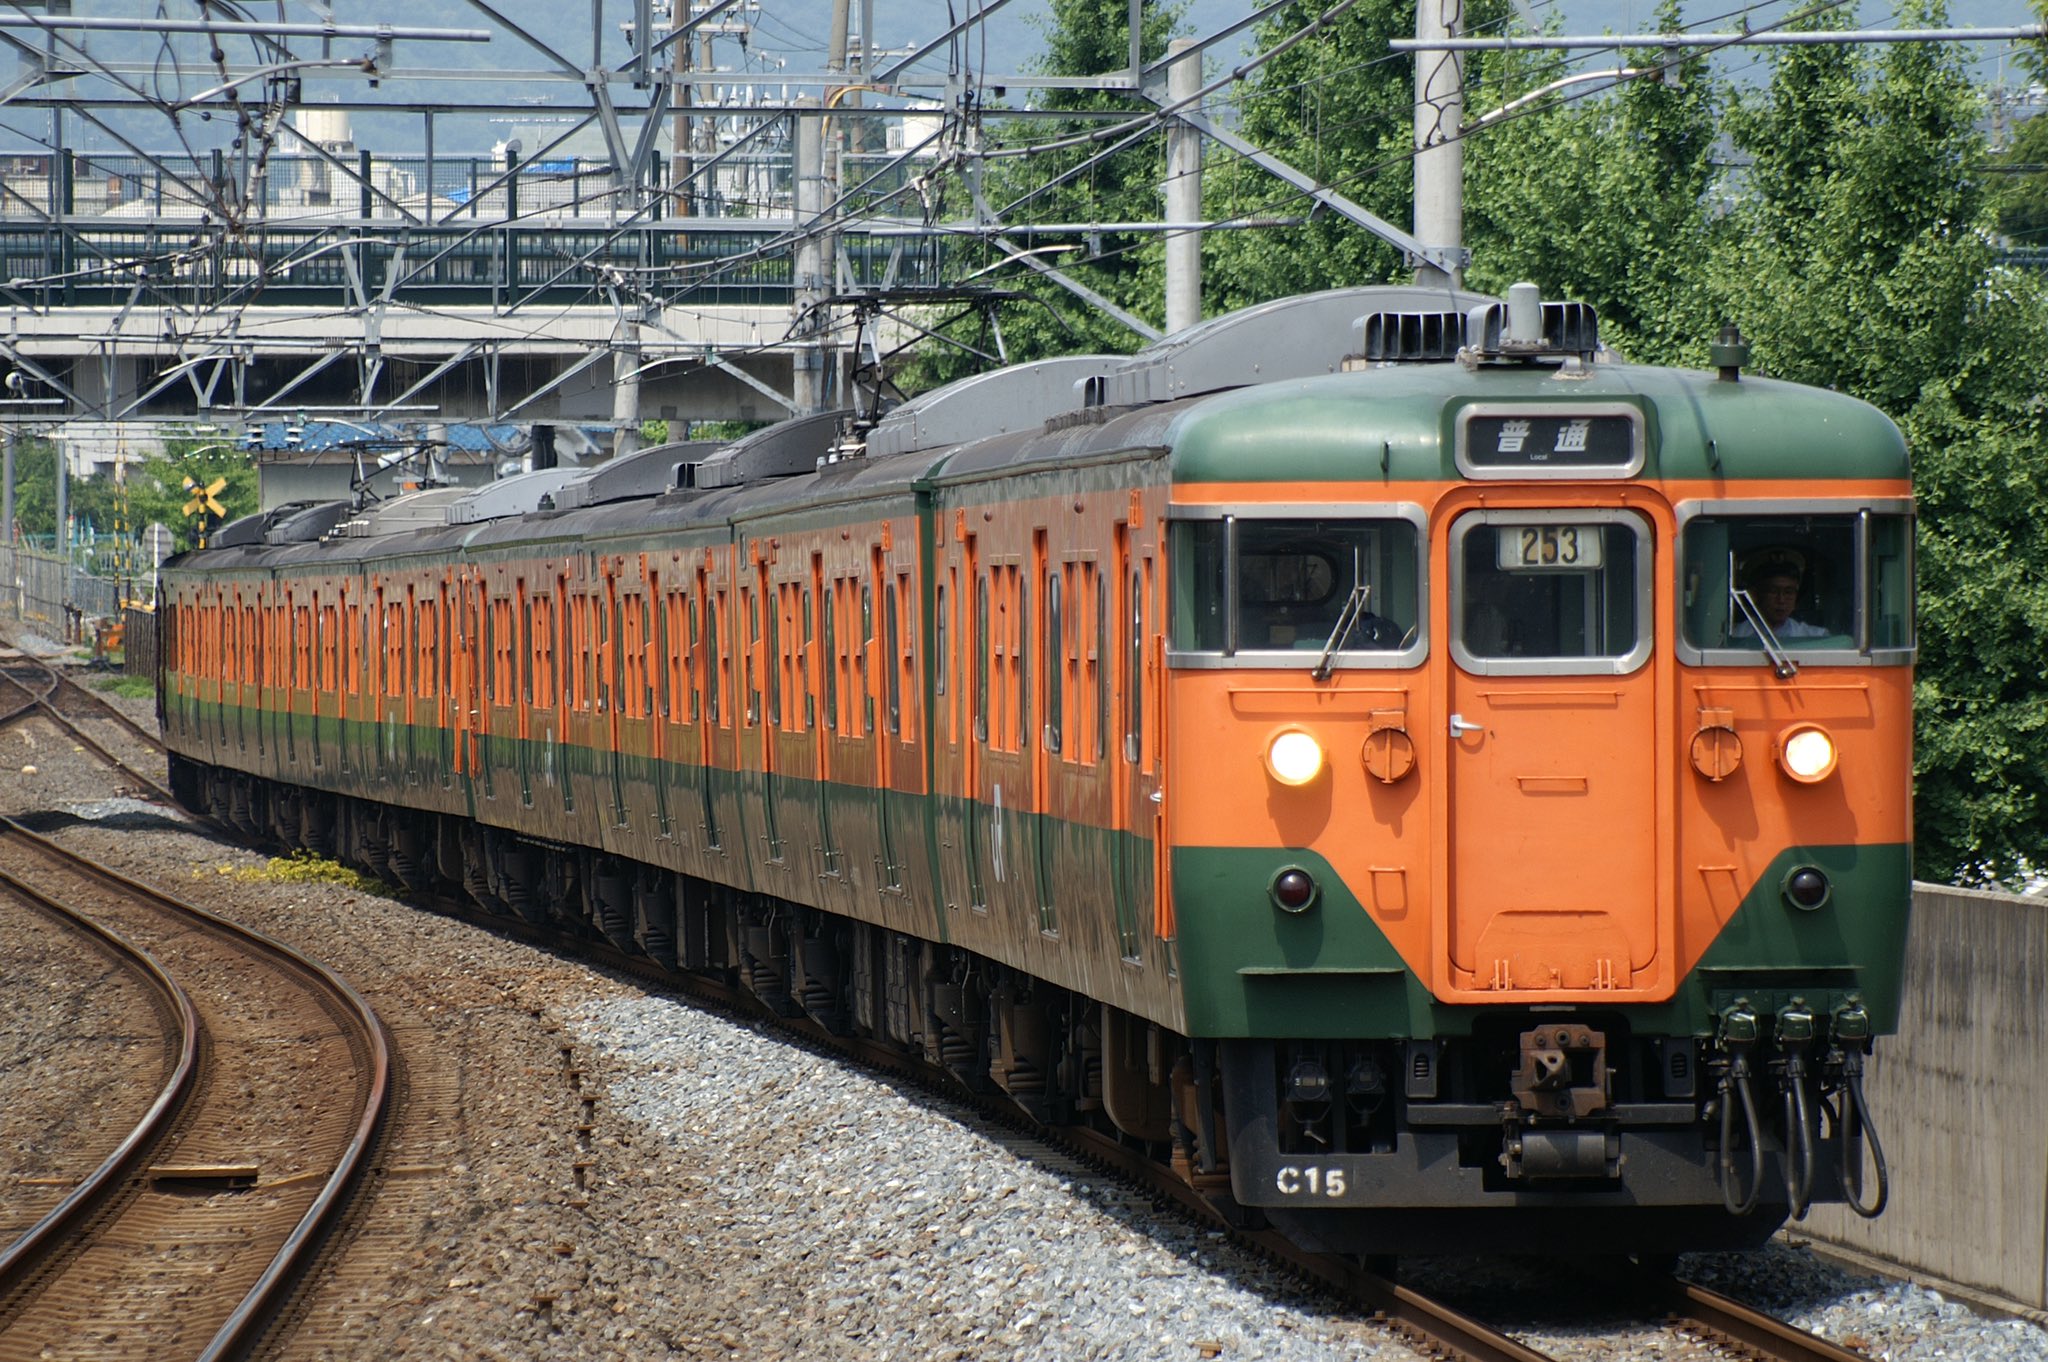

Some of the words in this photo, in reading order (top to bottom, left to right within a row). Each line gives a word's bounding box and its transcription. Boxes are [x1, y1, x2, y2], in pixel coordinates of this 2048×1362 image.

[1497, 419, 1592, 453] 普通
[1529, 453, 1548, 461] Local
[1521, 527, 1579, 566] 253
[1276, 1166, 1347, 1198] C15
